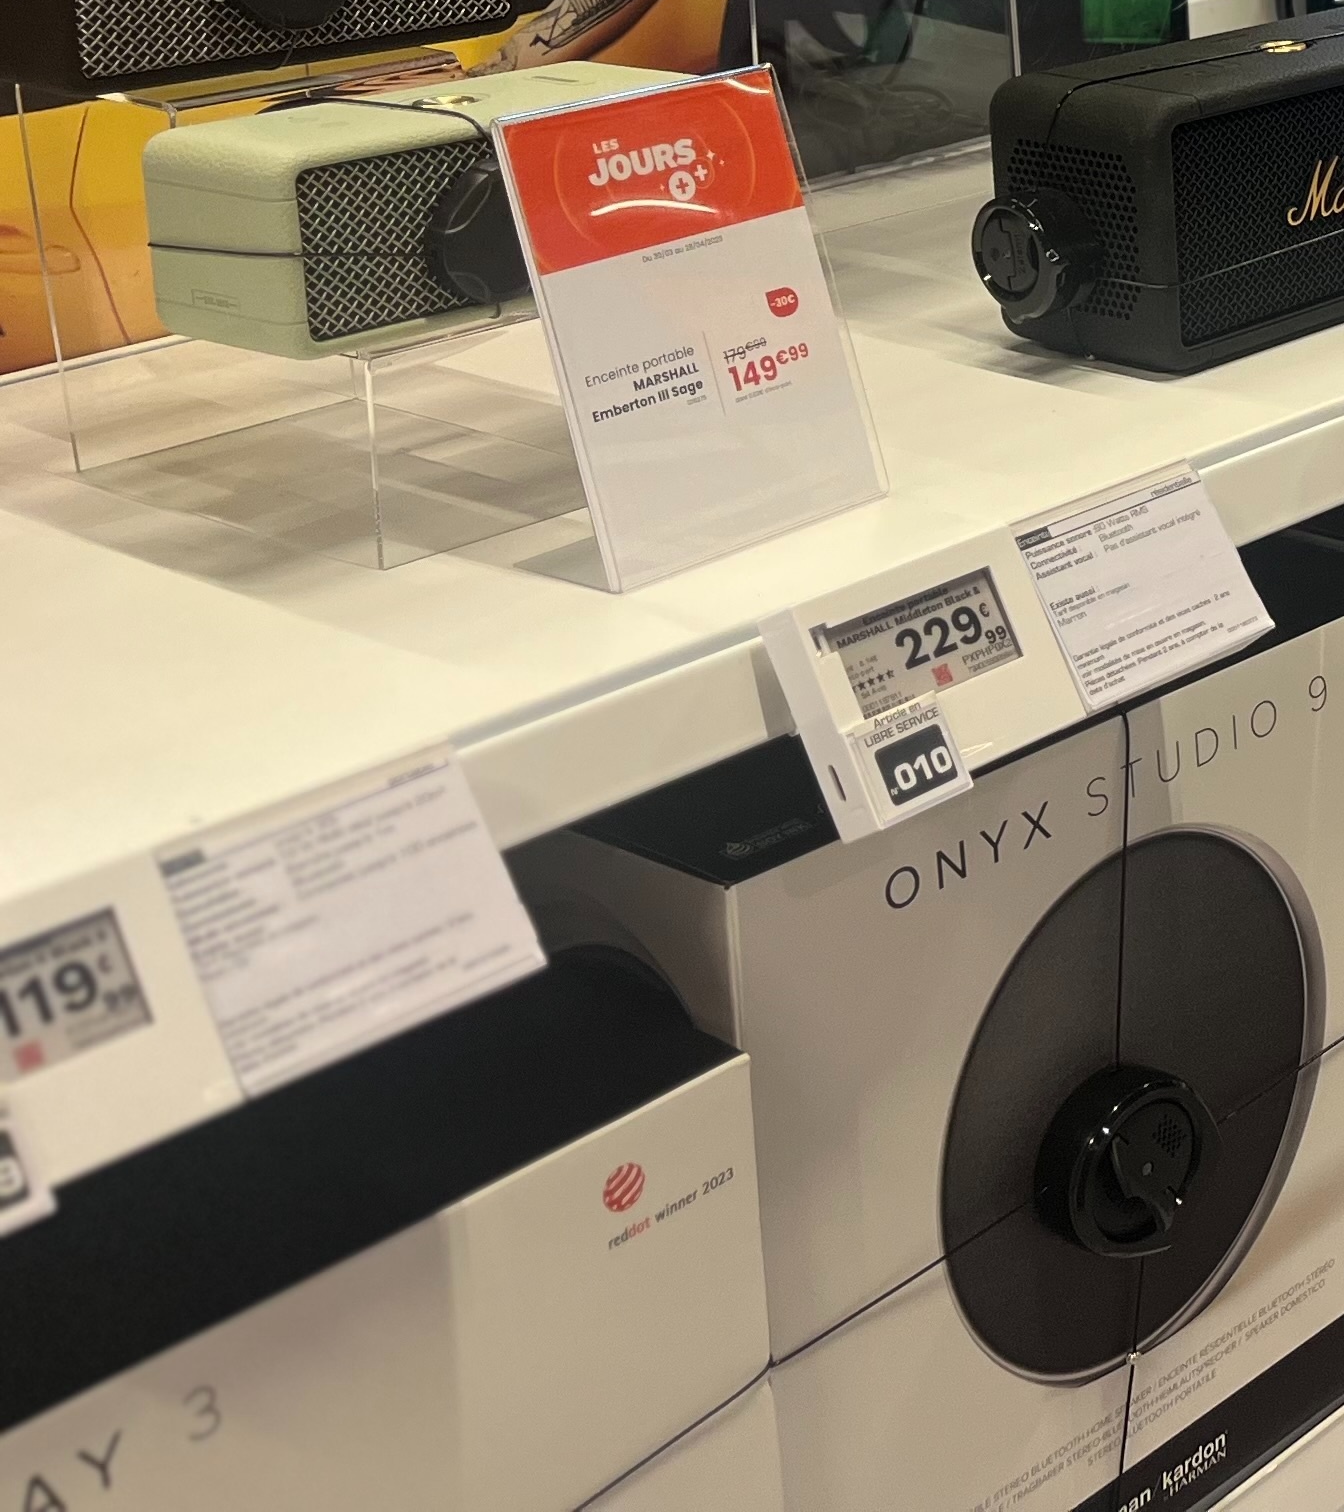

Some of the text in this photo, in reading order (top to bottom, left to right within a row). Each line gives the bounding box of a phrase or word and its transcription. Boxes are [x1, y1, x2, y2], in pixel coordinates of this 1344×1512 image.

[588, 138, 697, 187] JOURS
[592, 138, 620, 155] LES
[585, 345, 695, 388] Enceinte portable
[632, 361, 699, 392] MARSHALL
[592, 394, 657, 423] Emberton
[671, 380, 704, 400] Sage
[836, 620, 894, 649] MARSHALL
[894, 601, 944, 627] Middleton
[944, 590, 973, 606] Black
[979, 602, 990, 618] €
[895, 606, 982, 670] 229
[984, 625, 1007, 645] 99
[864, 706, 940, 748] LIBRE SERVICE
[873, 707, 908, 729] Article
[908, 701, 922, 713] en
[893, 745, 953, 791] 010
[885, 674, 1329, 909] ONYX STUDIO 9
[607, 1167, 736, 1250] reddot winner 2023
[1162, 1432, 1227, 1491] kardon
[1168, 1447, 1228, 1497] HARMAN
